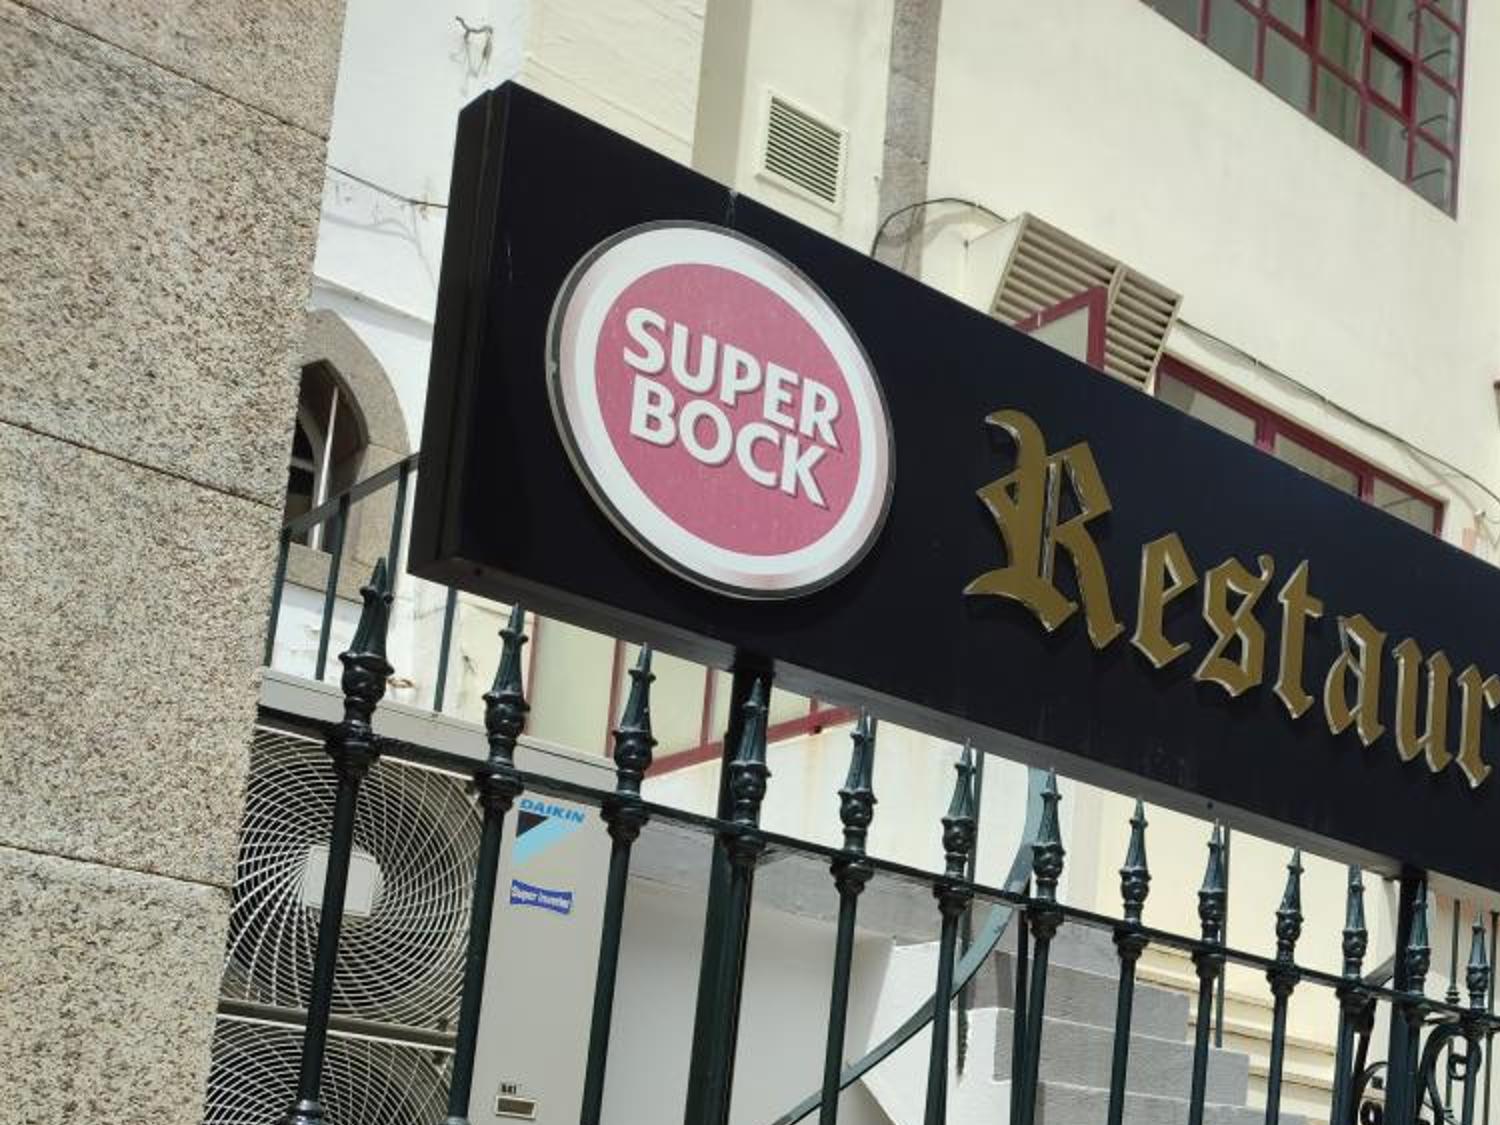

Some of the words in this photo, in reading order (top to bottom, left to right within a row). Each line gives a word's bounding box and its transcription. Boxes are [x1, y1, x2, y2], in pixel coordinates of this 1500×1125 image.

[623, 307, 843, 450] SUPER
[629, 374, 829, 509] BOCK
[520, 799, 585, 823] DAIKIN
